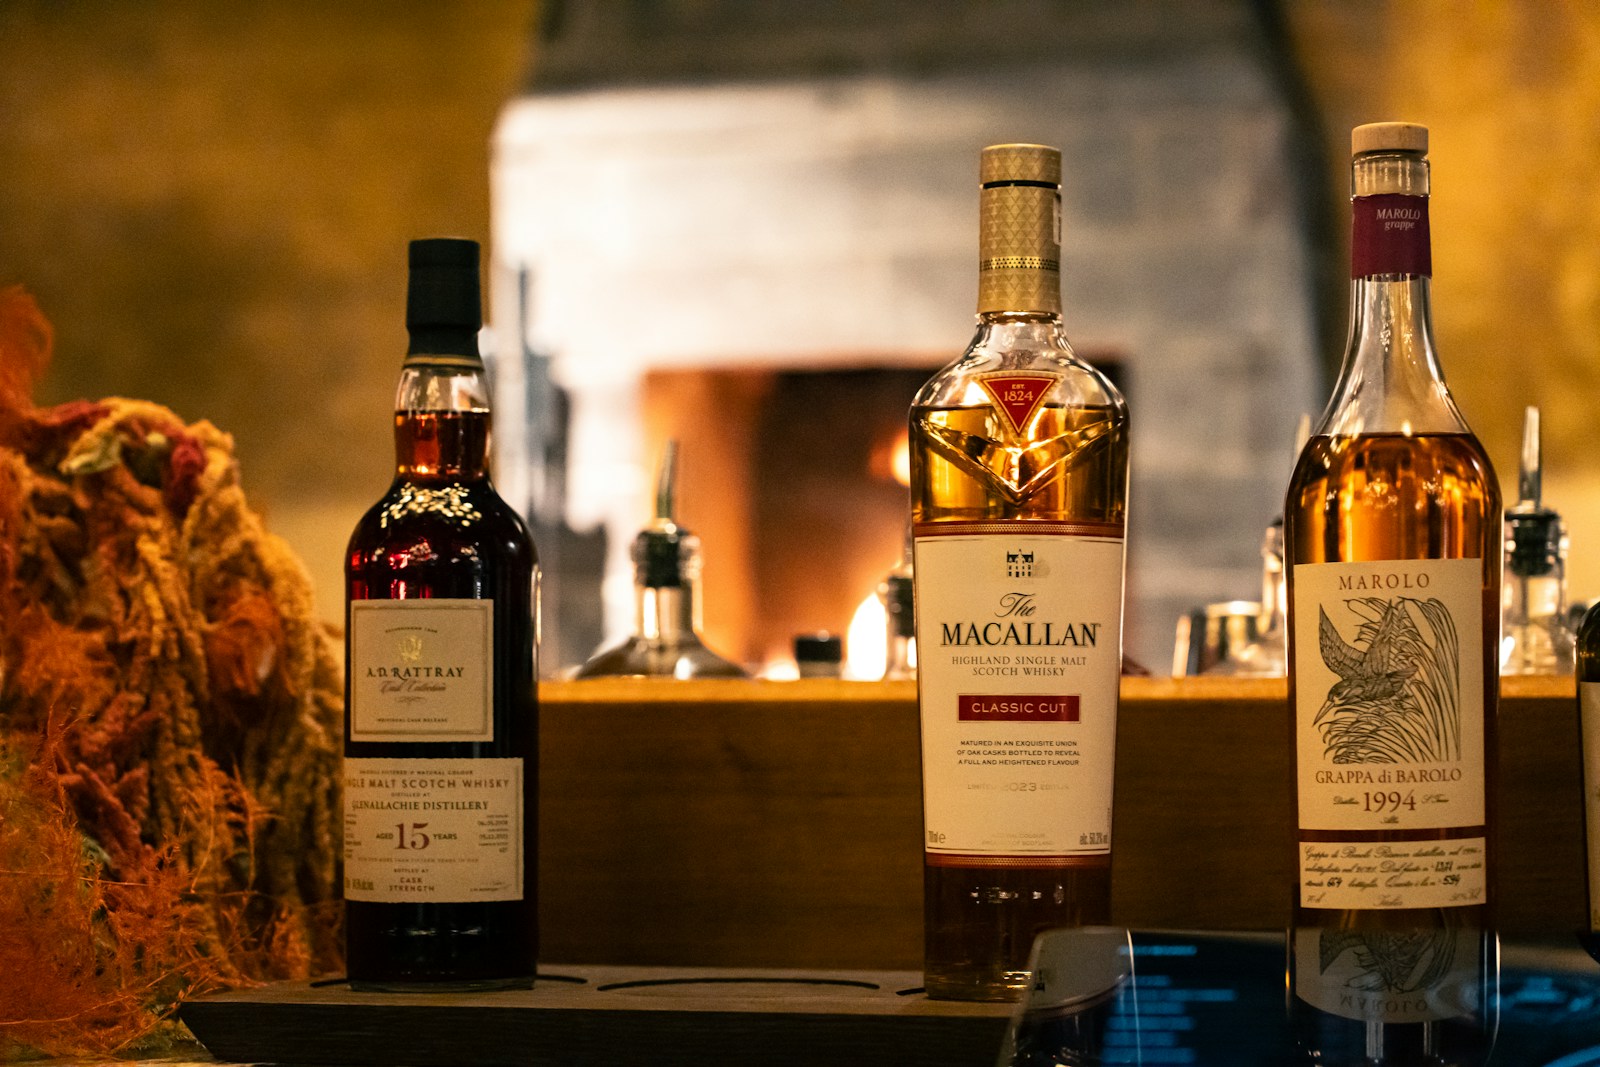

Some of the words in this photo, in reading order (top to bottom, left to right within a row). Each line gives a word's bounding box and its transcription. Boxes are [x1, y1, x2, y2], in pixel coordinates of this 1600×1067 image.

[1376, 208, 1421, 220] MAROLO
[1384, 220, 1415, 231] grappe
[1003, 390, 1034, 402] 1824
[1338, 572, 1431, 592] MAROLO
[993, 592, 1039, 619] The
[940, 622, 1100, 647] MACALLAN
[951, 656, 1011, 666] HIGHLAND
[1015, 656, 1057, 666] SINGLE
[1060, 656, 1087, 666] MALT
[972, 667, 1018, 677] SCOTCH
[1023, 667, 1066, 677] WHISKY
[971, 702, 1034, 714] CLASSIC
[1038, 702, 1068, 714] CUT
[1315, 769, 1374, 785] GRAPPA
[1377, 768, 1391, 783] di
[1396, 768, 1463, 783] BAROLO
[368, 778, 396, 788] MALT
[401, 779, 456, 789] SCOTCH
[462, 779, 509, 788] WHISKY
[422, 801, 489, 811] DISTILLERY
[1363, 789, 1417, 813] 1994
[393, 822, 431, 851] 15
[432, 833, 458, 841] YEARS
